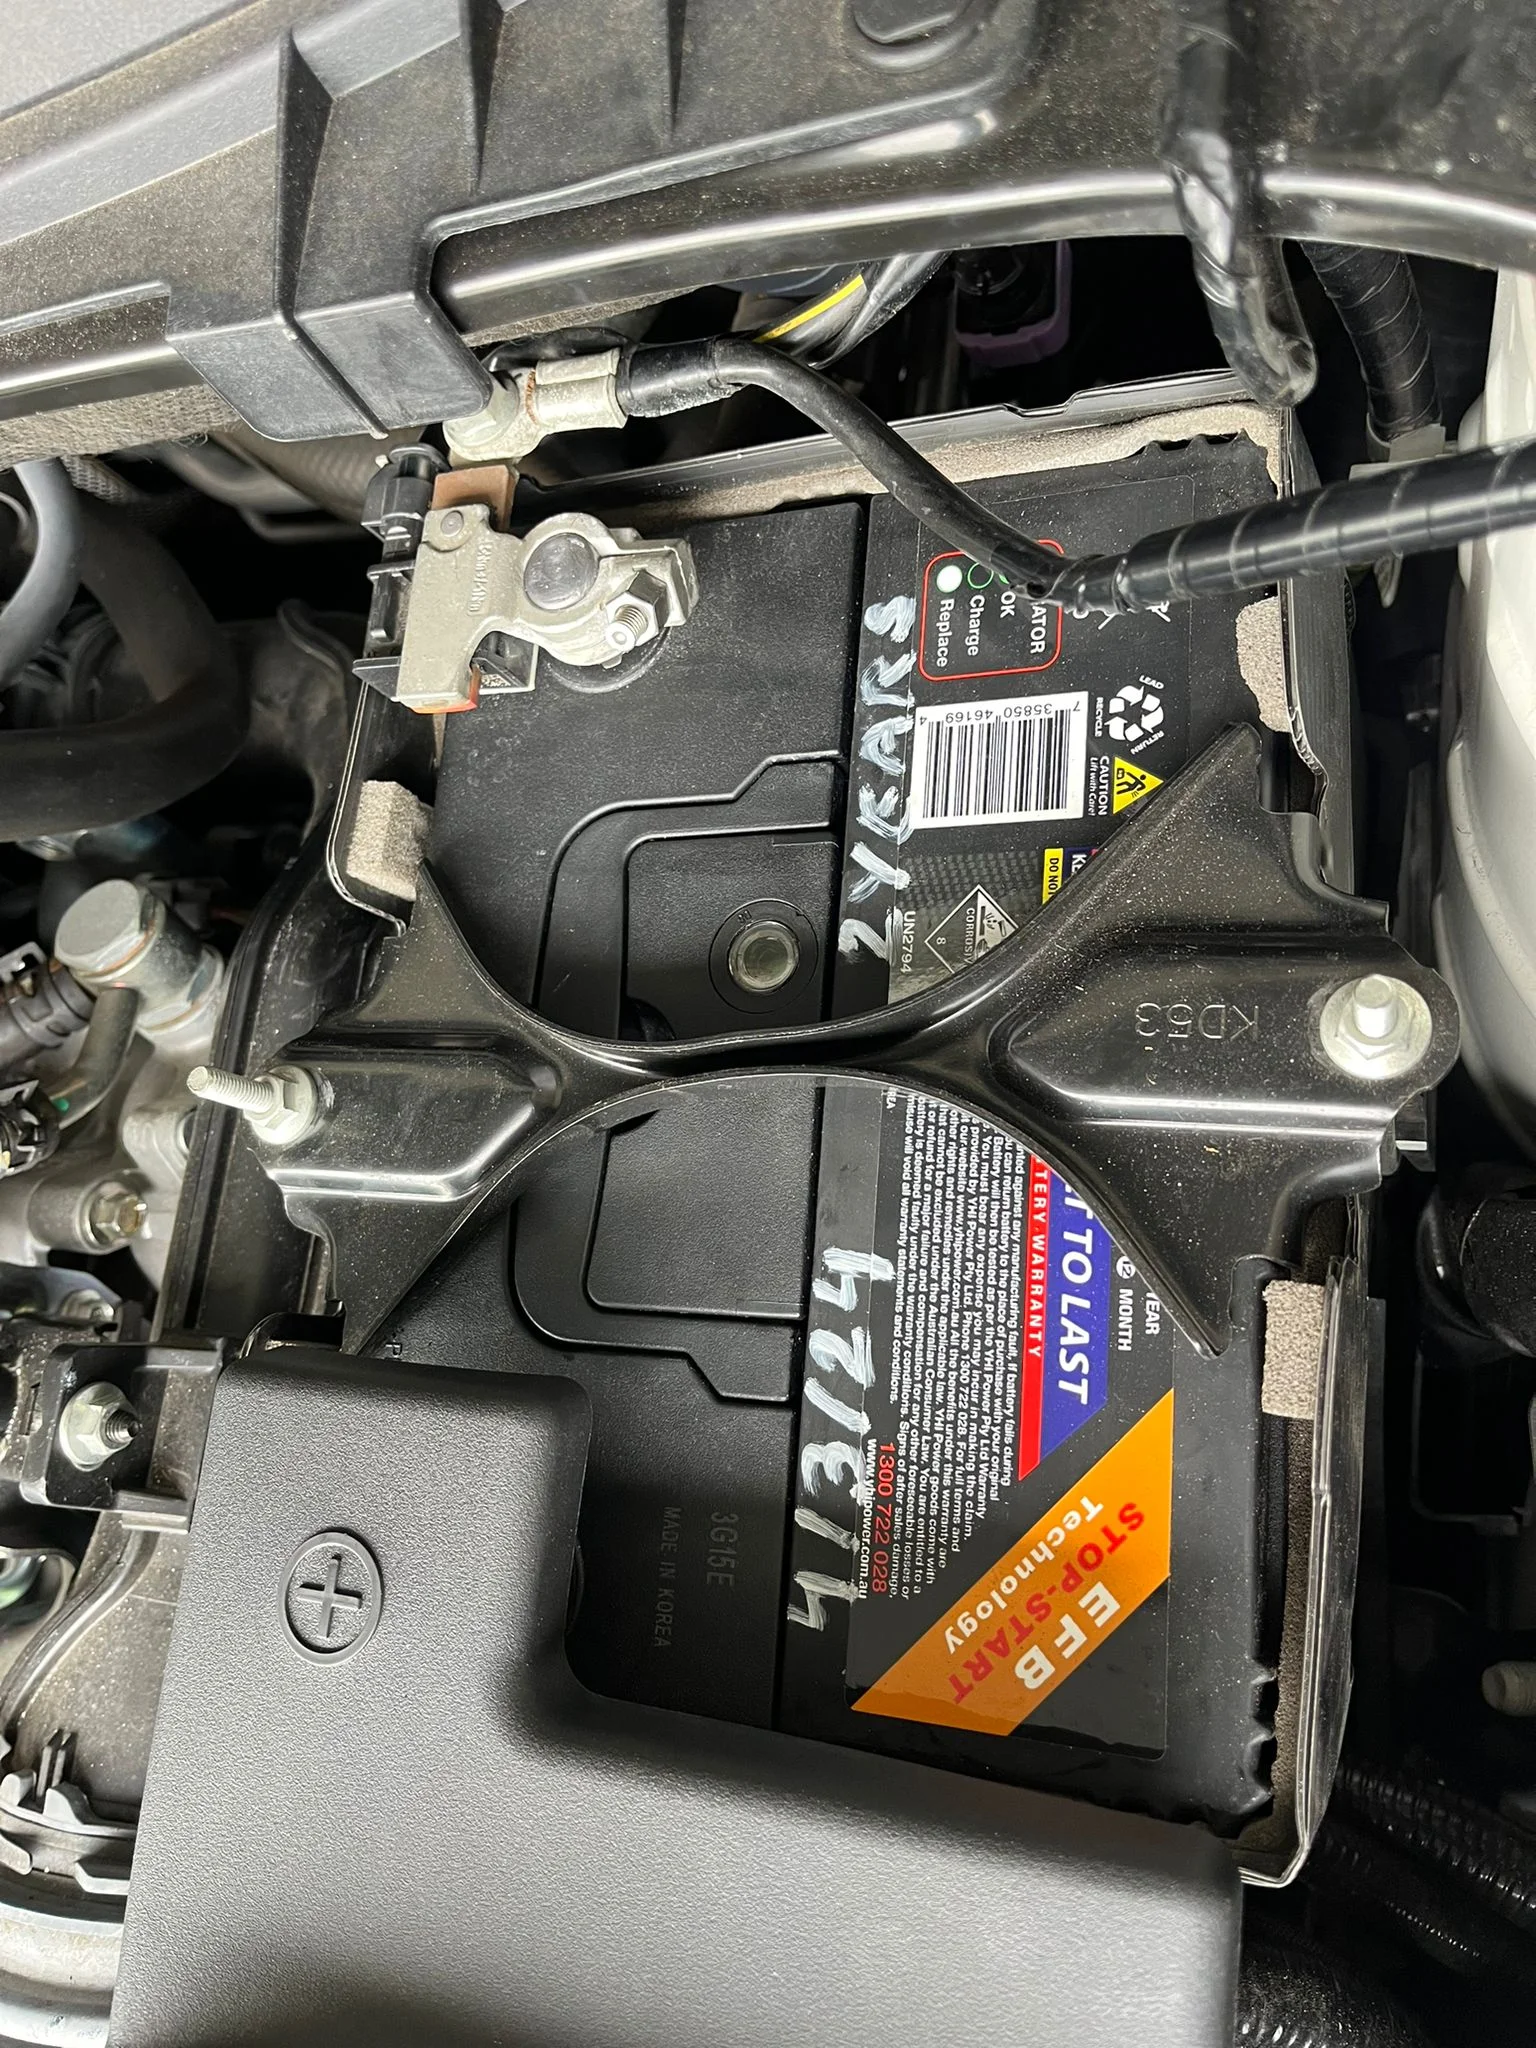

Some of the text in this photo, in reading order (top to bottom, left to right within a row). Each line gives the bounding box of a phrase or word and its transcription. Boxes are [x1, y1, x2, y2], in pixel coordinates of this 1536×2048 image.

[1000, 591, 1016, 618] OK
[936, 598, 955, 667] Replace
[965, 594, 985, 656] Charge
[1139, 675, 1165, 690] LEAD
[920, 701, 1081, 726] 7 35850 46169 4
[1095, 697, 1104, 737] RECYCLE
[1130, 730, 1165, 755] RETURN
[838, 595, 917, 966] 2 YEARS
[1088, 757, 1098, 816] Lift with Care!
[1098, 756, 1109, 816] CAUTION
[1048, 857, 1059, 872] DO
[900, 910, 916, 973] UN2794
[935, 937, 945, 945] 8
[963, 908, 975, 965] CORROSIV
[903, 1135, 915, 1154] will
[935, 1128, 948, 1168] cannot
[959, 1124, 969, 1144] our
[981, 1135, 993, 1159] You
[902, 1155, 914, 1180] void
[911, 1150, 925, 1198] deemed
[944, 1141, 958, 1174] rights
[956, 1146, 970, 1192] website
[979, 1161, 992, 1192] must
[1003, 1151, 1013, 1173] can
[945, 1176, 957, 1199] and
[1001, 1175, 1014, 1209] return
[1010, 1175, 1025, 1217] against
[896, 1197, 911, 1247] warranty
[907, 1200, 922, 1233] faulty
[931, 1188, 945, 1243] excluded
[942, 1200, 956, 1255] remedies
[977, 1195, 990, 1224] bear
[974, 1227, 986, 1250] any
[997, 1210, 1012, 1252] battery
[1009, 1219, 1021, 1242] any
[907, 1235, 920, 1270] under
[929, 1245, 942, 1280] under
[947, 1194, 967, 1327] www.yhipower.com.au
[1028, 1160, 1047, 1358] TERY WARRANTY
[1059, 1229, 1092, 1284] TO
[894, 1248, 909, 1313] statements
[906, 1272, 918, 1293] the
[928, 1282, 940, 1302] the
[940, 1255, 953, 1292] under
[971, 1253, 985, 1308] expense
[998, 1268, 1010, 1288] the
[1005, 1243, 1022, 1328] manufacturing
[901, 1294, 917, 1348] warranty
[939, 1293, 951, 1313] the
[970, 1310, 982, 1335] you
[994, 1289, 1009, 1323] place
[1116, 1289, 1133, 1352] MONTH
[893, 1314, 905, 1337] and
[925, 1304, 939, 1366] Australian
[949, 1329, 960, 1345] All
[950, 1126, 982, 1551] provided YHI Power Pty Ltd. Phone 1300 722 028. For full terms and
[973, 1136, 1004, 1518] Battery will then tested the YHI Power Pty Ltd Warranty
[1005, 1330, 1018, 1360] fault,
[902, 1124, 937, 1582] refund for major failure and compensation for any other foreseeable losses
[933, 1315, 949, 1379] applicable
[948, 1348, 960, 1368] the
[968, 1338, 981, 1366] may
[991, 1339, 1007, 1395] purchase
[1056, 1293, 1089, 1405] LAST
[889, 1338, 903, 1404] conditions.
[899, 1349, 914, 1418] conditions.
[969, 1369, 981, 1403] incur
[921, 1368, 935, 1433] Consumer
[934, 1380, 946, 1405] law.
[945, 1370, 959, 1421] benefits
[992, 1397, 1004, 1423] with
[1001, 1372, 1016, 1416] battery
[895, 1420, 910, 1456] Signs
[933, 1407, 945, 1430] YHI
[1002, 1418, 1014, 1444] fails
[919, 1435, 932, 1464] Law.
[930, 1433, 943, 1473] Power
[943, 1423, 956, 1460] under
[963, 1422, 979, 1471] making
[988, 1425, 1001, 1454] your
[918, 1467, 930, 1491] You
[942, 1463, 954, 1486] this
[964, 1474, 976, 1496] the
[986, 1455, 1002, 1500] original
[998, 1445, 1013, 1486] during
[894, 1474, 907, 1504] after
[926, 1475, 941, 1515] goods
[857, 1438, 878, 1598] www.yhipower.com.au
[872, 1442, 895, 1593] 1300 722 028
[892, 1507, 905, 1539] sales
[926, 1518, 937, 1553] come
[937, 1489, 953, 1544] warranty
[962, 1500, 975, 1540] claim.
[706, 1511, 740, 1587] 3G15E
[914, 1517, 927, 1565] entitled
[654, 1506, 681, 1648] MADE IN KOREA
[887, 1543, 903, 1598] damage,
[925, 1557, 937, 1583] with
[944, 1496, 1105, 1654] Technology
[947, 1502, 1145, 1705] STOP-START
